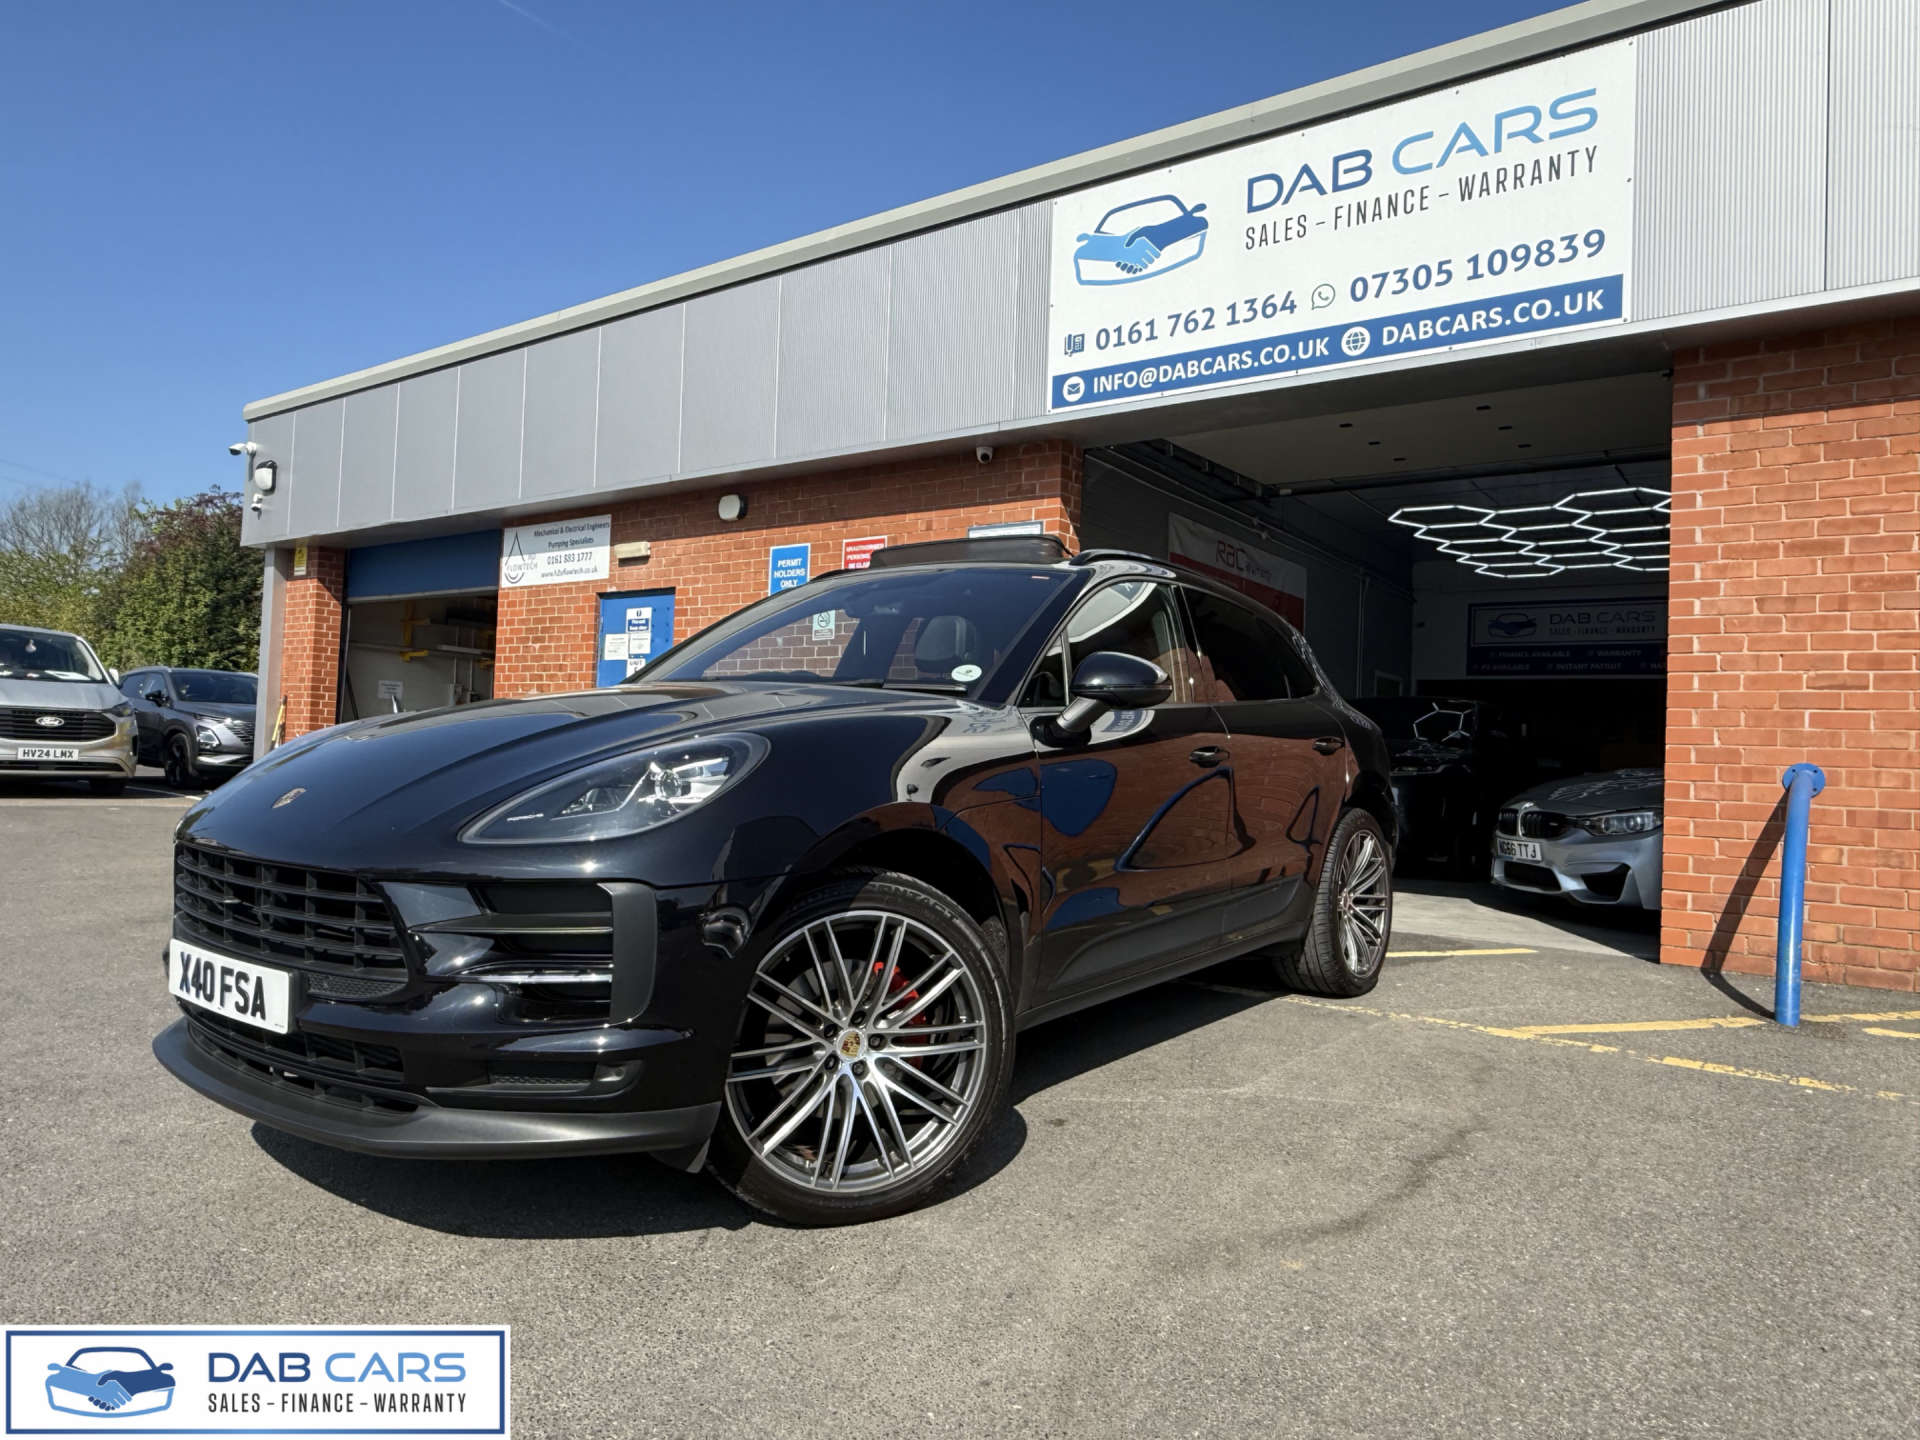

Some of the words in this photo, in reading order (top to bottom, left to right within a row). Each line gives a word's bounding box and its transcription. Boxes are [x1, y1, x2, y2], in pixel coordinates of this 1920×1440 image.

[1246, 149, 1373, 214] DAB
[1392, 88, 1598, 175] CARS
[1245, 214, 1308, 251] SALES
[1334, 185, 1430, 231] FINANCE
[1458, 145, 1598, 202] WARRANTY
[1350, 259, 1453, 303] 07305
[1466, 229, 1606, 281] 109839
[1095, 318, 1158, 351] 0161
[1168, 307, 1216, 337] 762
[1226, 290, 1297, 327] 1364
[1382, 289, 1605, 346] DABCARS.CO.UK
[1093, 337, 1330, 394] INFO@DABCARS.CO.UK
[774, 568, 806, 578] HOLDERS
[777, 558, 803, 567] PERMIT
[780, 579, 798, 588] ONLY
[1550, 612, 1591, 625] DAB
[1596, 610, 1656, 624] CARS
[23, 749, 50, 758] HV24
[53, 750, 74, 759] LMX
[179, 951, 215, 1003] X40
[219, 965, 266, 1021] FSA
